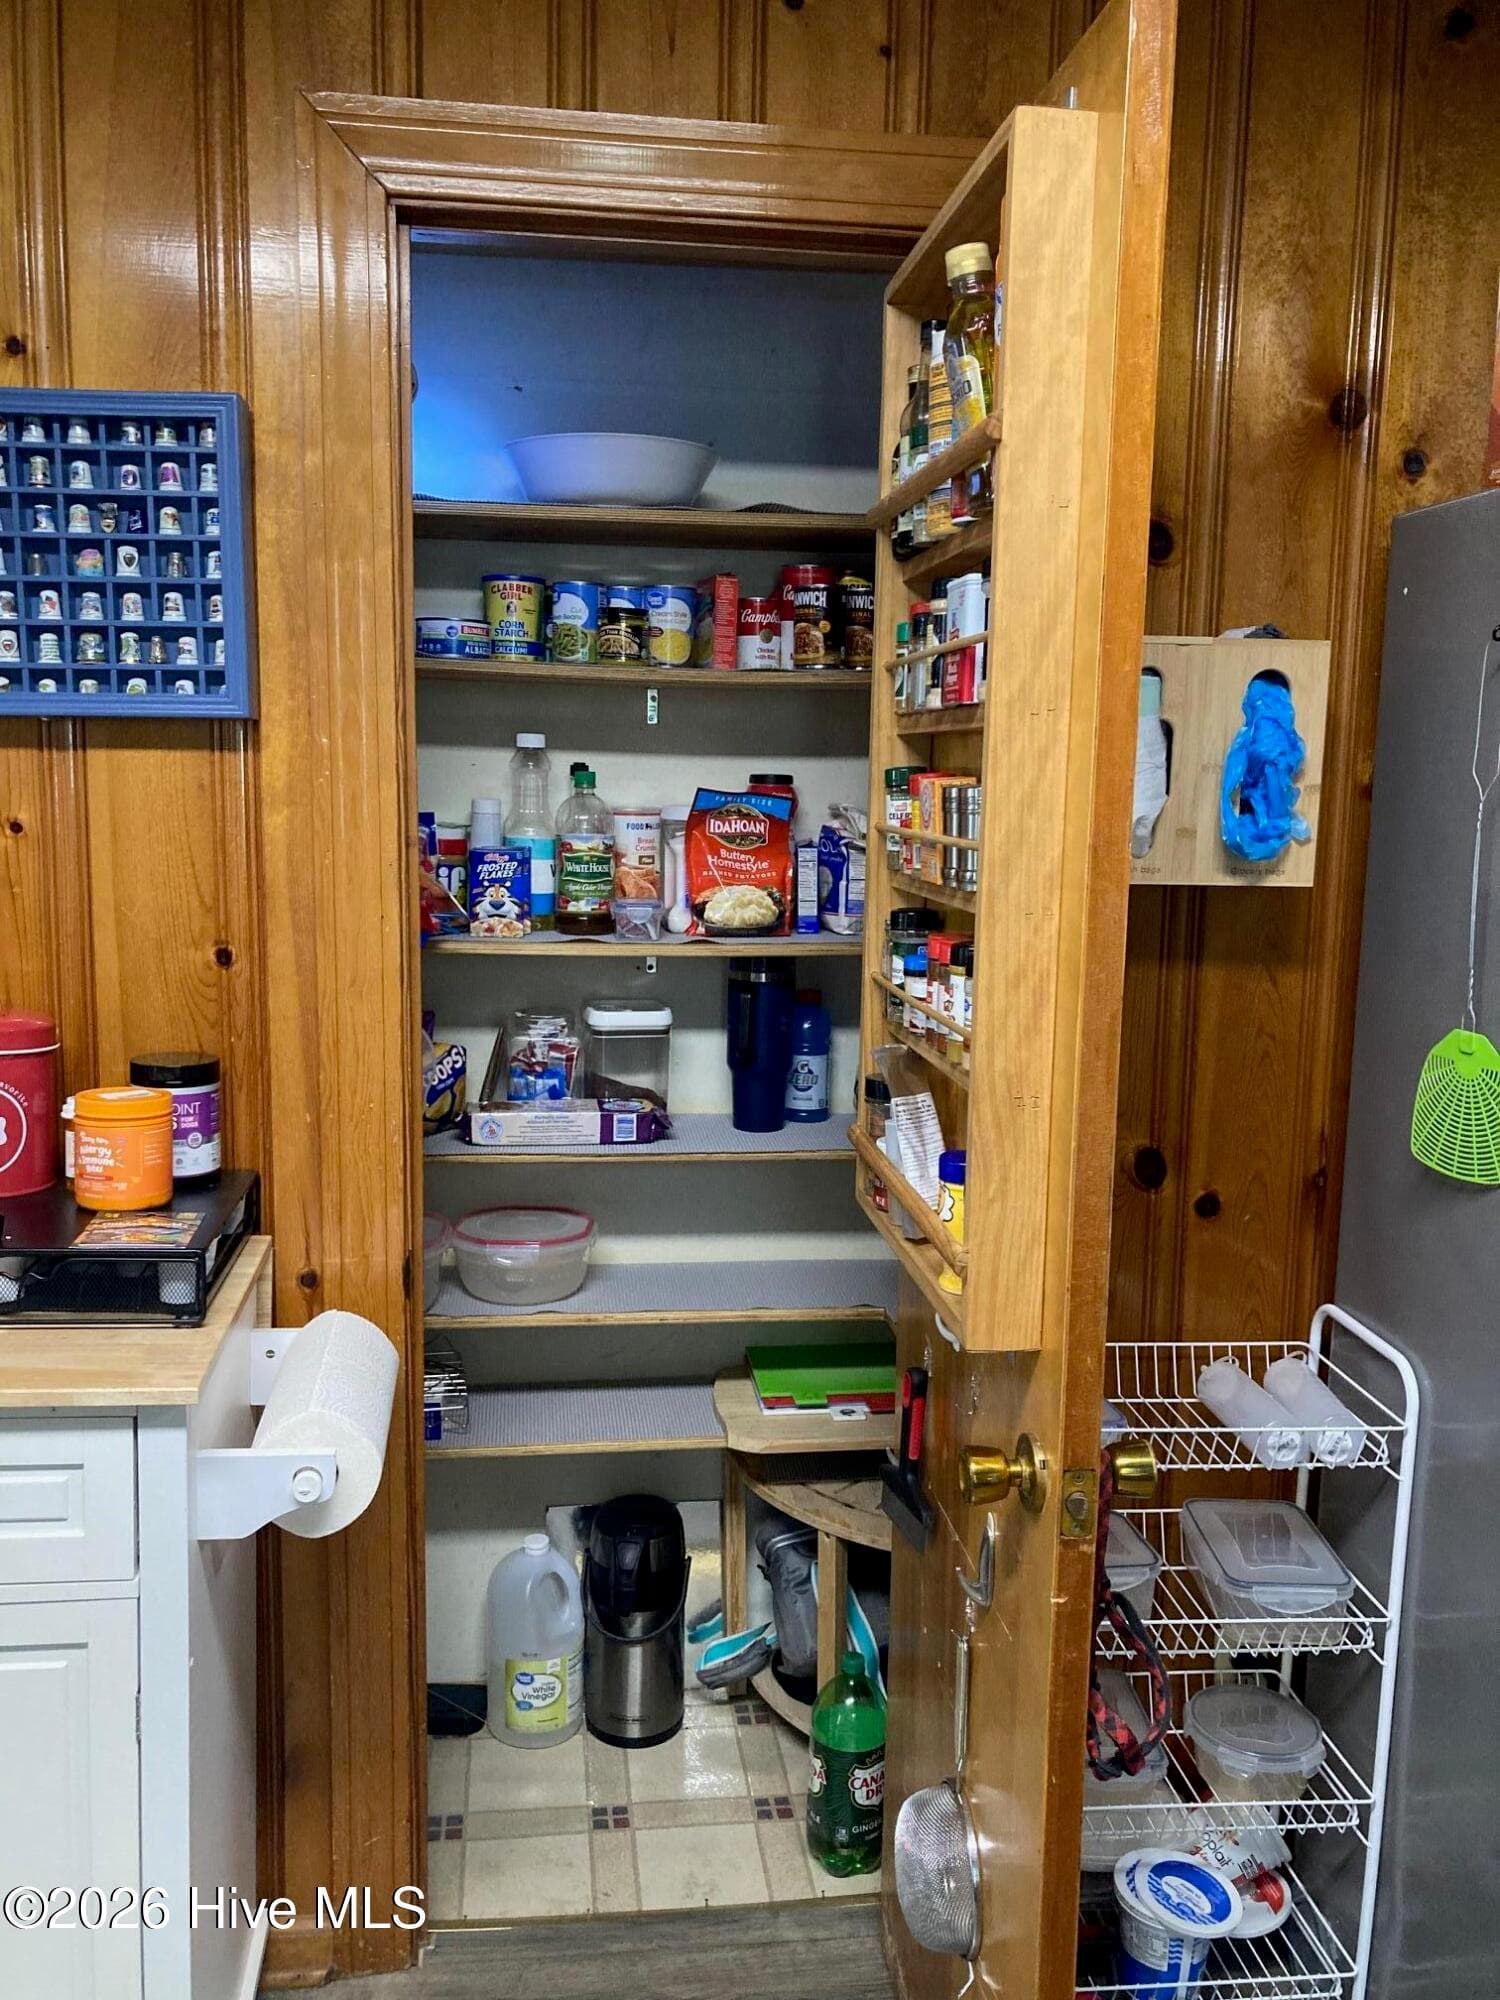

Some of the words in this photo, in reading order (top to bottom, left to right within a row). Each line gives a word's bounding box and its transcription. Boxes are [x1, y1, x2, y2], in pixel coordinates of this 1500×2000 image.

[491, 583, 533, 595] CLABBER
[500, 591, 523, 601] GIRL
[499, 620, 525, 630] CORN
[494, 629, 529, 638] STARCH
[716, 795, 746, 803] FAMILY
[750, 798, 773, 806] SIZE
[626, 822, 645, 830] FOOD
[709, 818, 765, 834] IDAHOAN
[720, 848, 756, 864] Buttery
[476, 861, 518, 873] FROSTED
[707, 855, 769, 873] Homestyle
[479, 869, 515, 880] FLAKES
[532, 1685, 557, 1694] White
[521, 1691, 555, 1702] Vinegar
